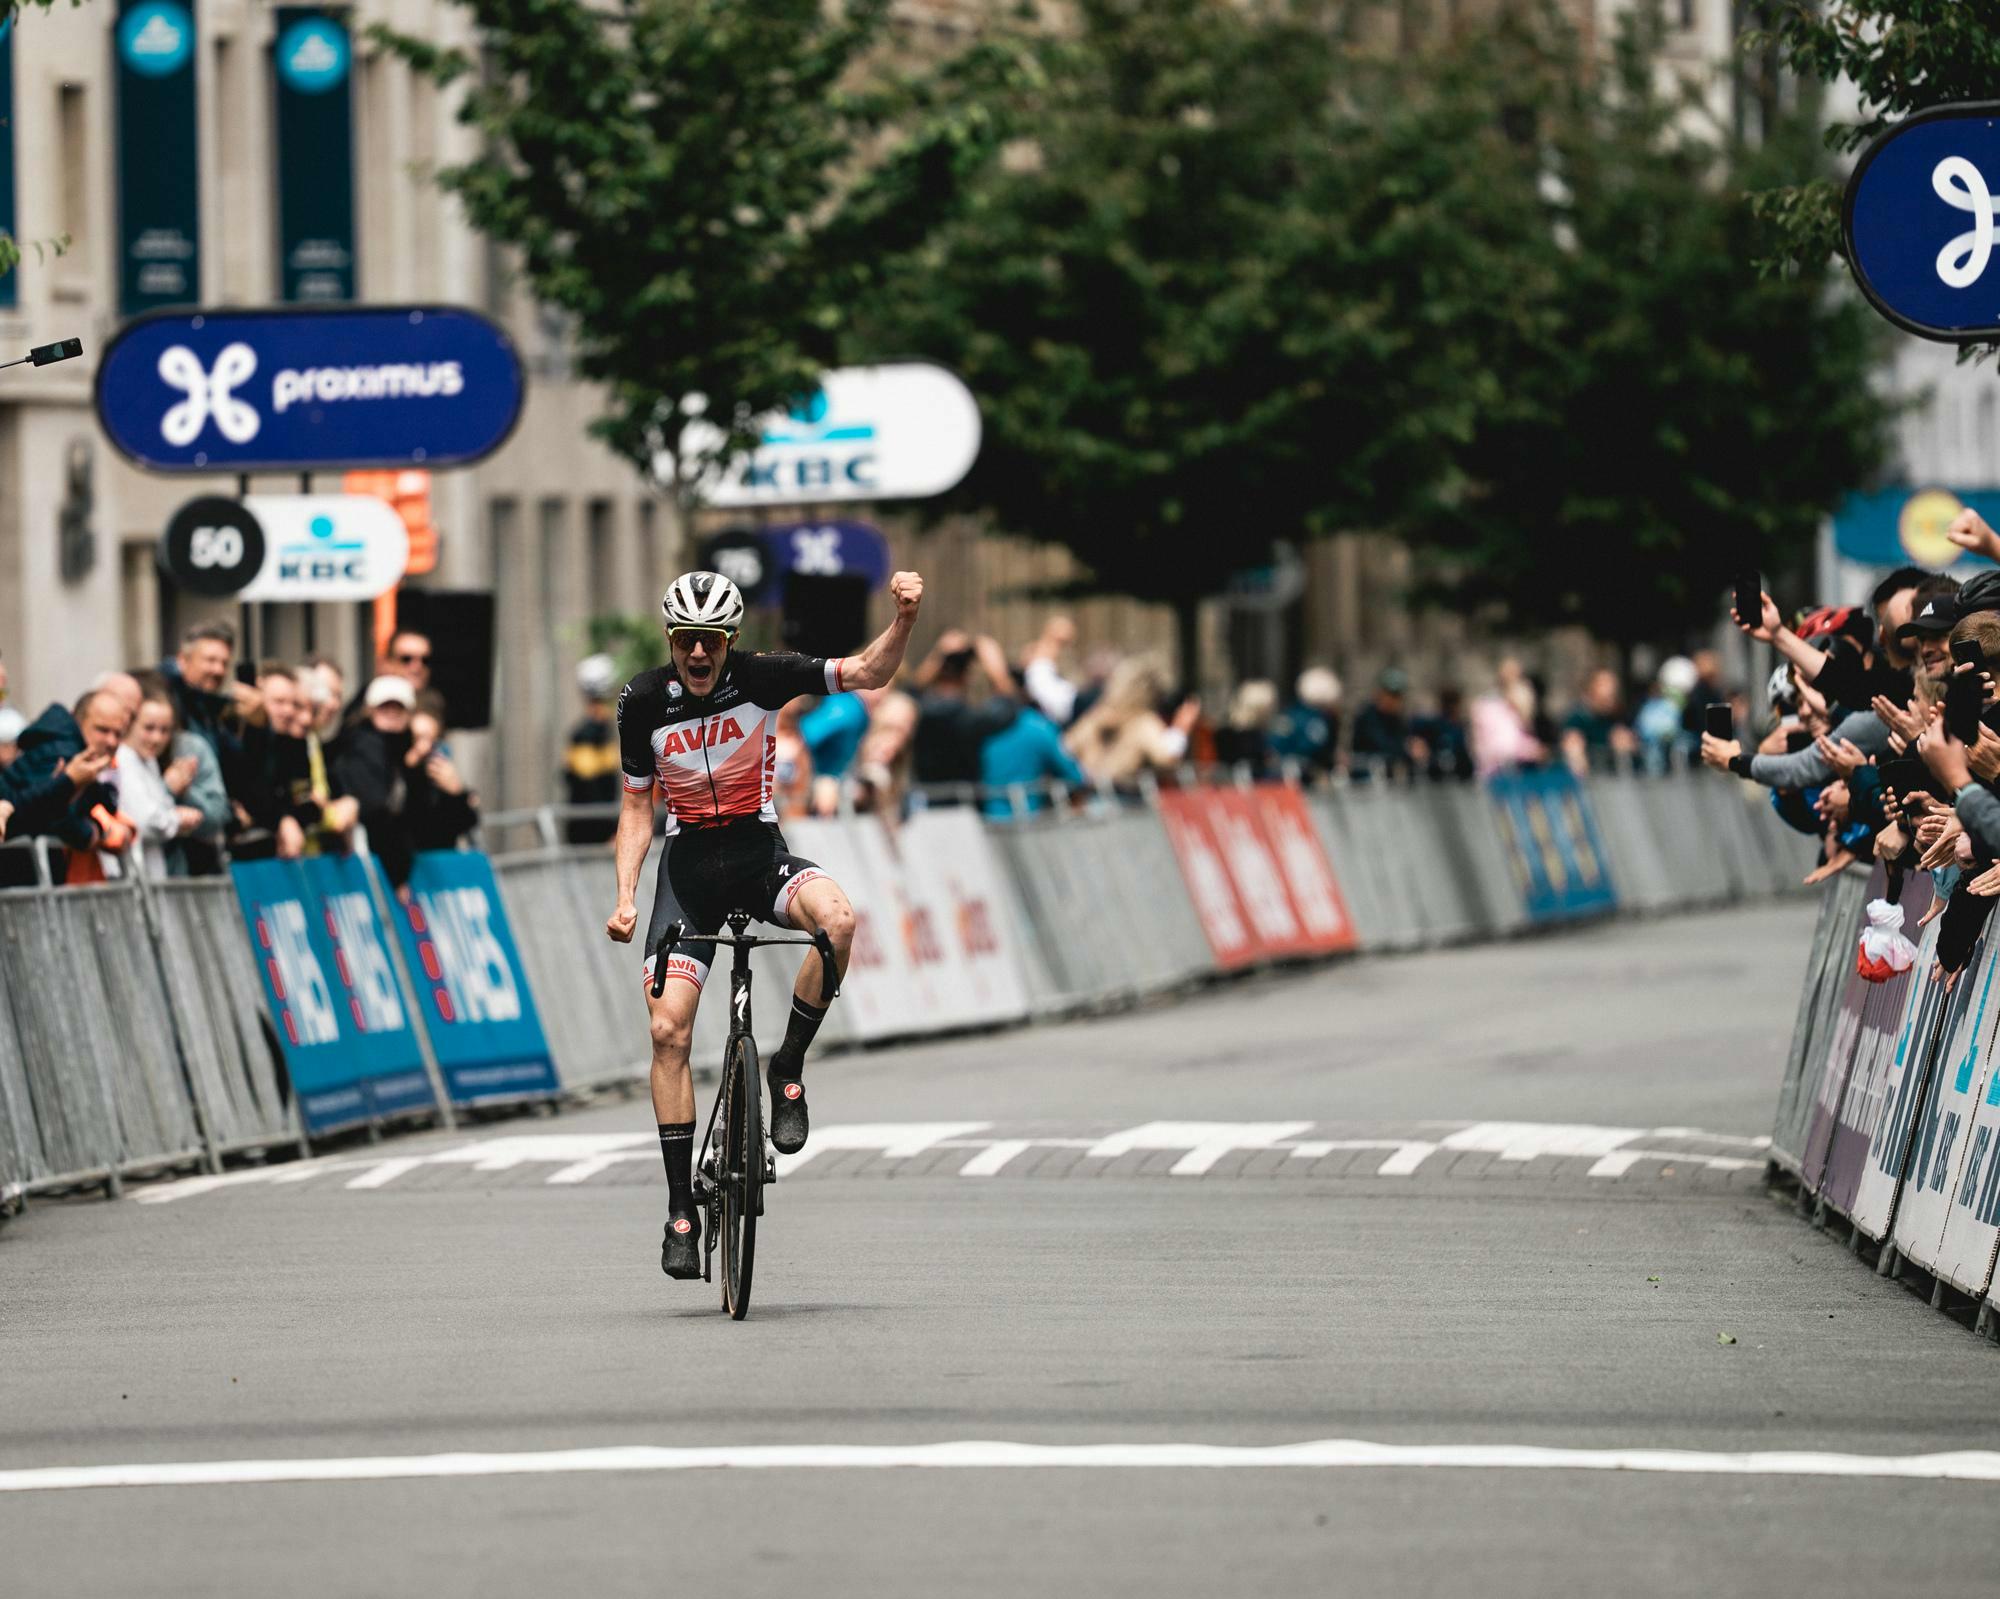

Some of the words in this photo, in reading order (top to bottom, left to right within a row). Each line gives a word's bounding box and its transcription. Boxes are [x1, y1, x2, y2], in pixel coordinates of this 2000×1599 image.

[272, 361, 464, 413] proximus
[747, 454, 875, 486] KBC
[190, 525, 244, 569] 50
[279, 561, 363, 581] KBC
